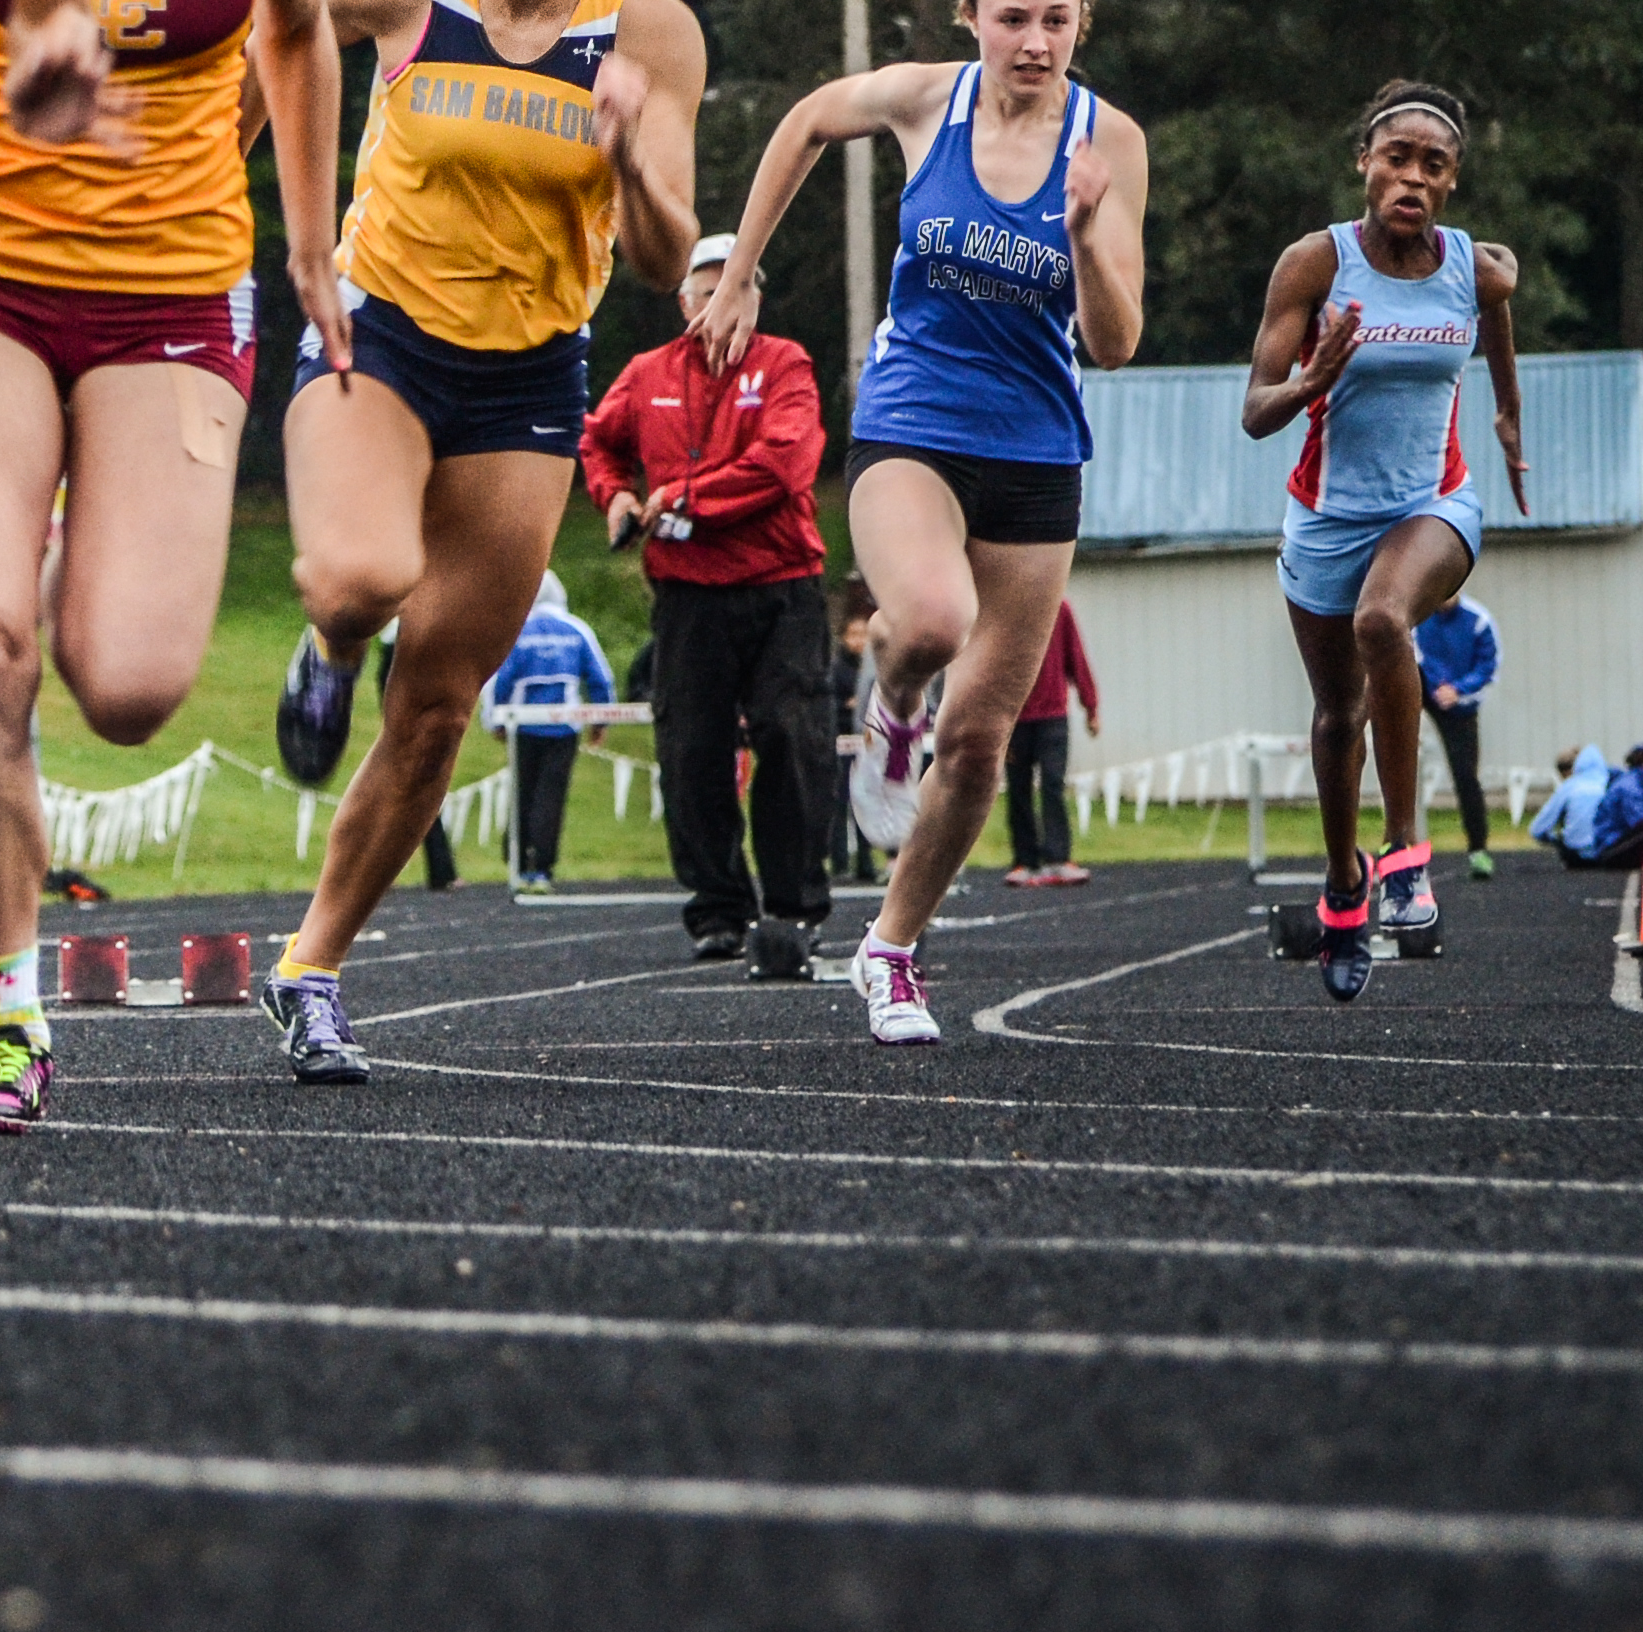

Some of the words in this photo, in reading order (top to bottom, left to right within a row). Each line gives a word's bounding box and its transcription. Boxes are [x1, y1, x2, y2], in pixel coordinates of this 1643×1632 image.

[410, 75, 476, 119] SAM
[483, 84, 599, 148] BARLOW
[916, 217, 954, 255] ST.
[961, 220, 1070, 290] MARY'S
[928, 261, 1053, 316] ACADEMY
[1351, 317, 1472, 346] entennial
